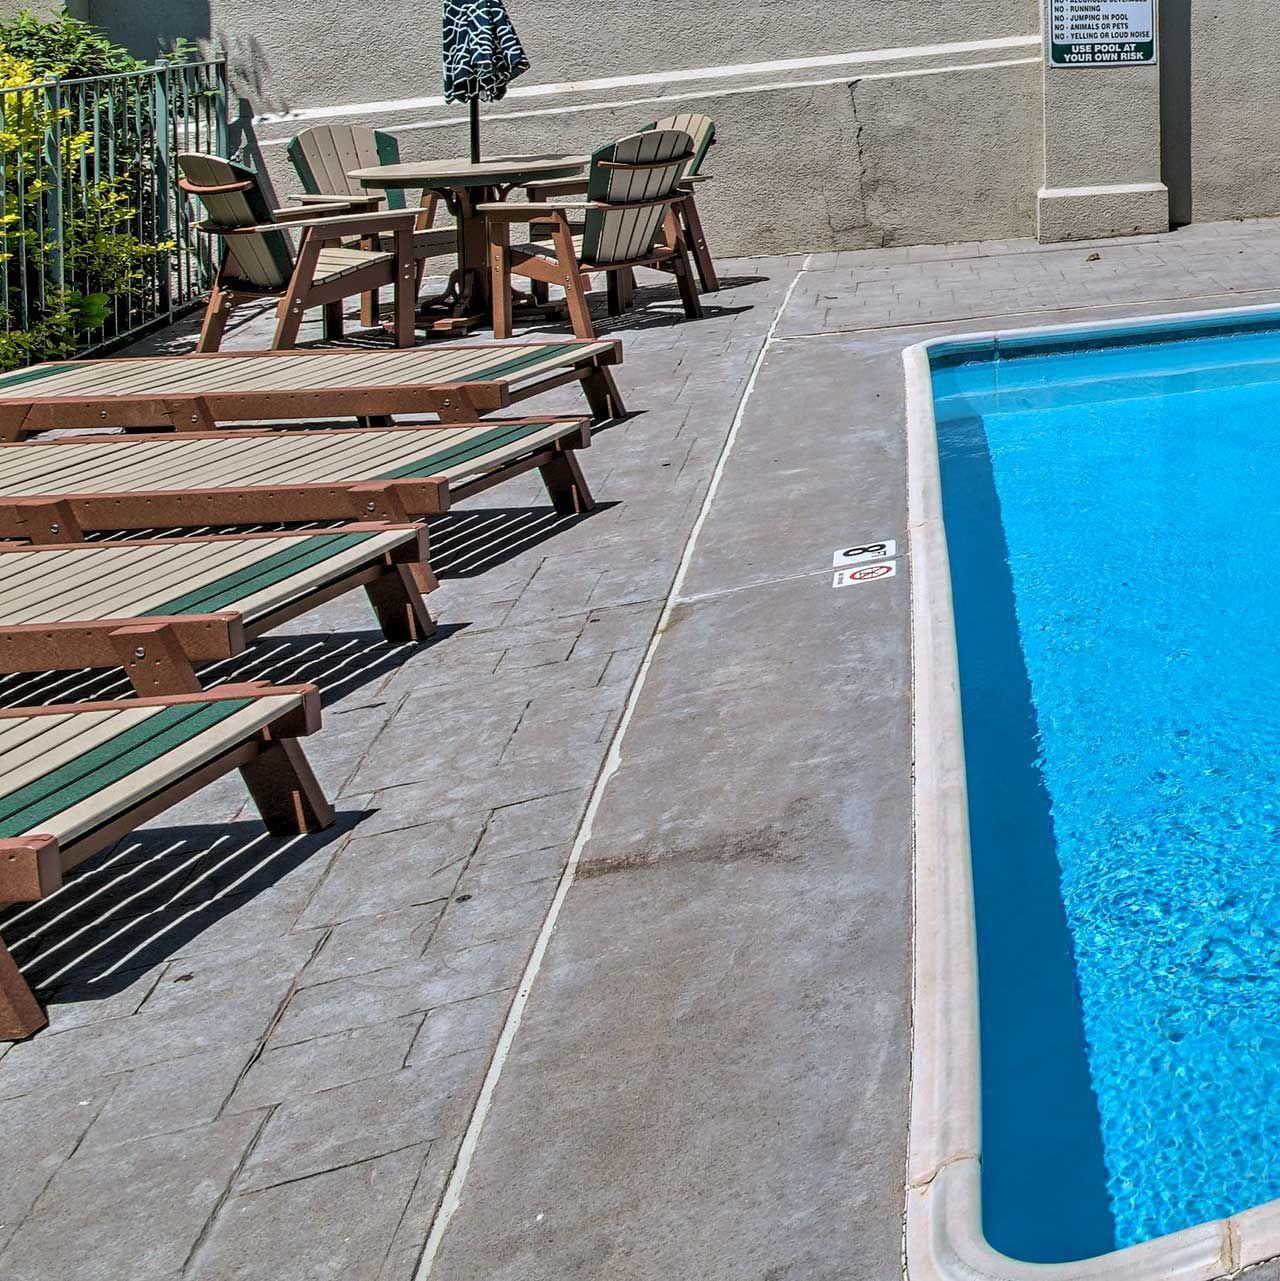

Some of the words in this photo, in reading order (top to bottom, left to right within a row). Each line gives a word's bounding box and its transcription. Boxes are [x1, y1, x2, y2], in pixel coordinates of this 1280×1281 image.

[1095, 53, 1117, 61] OWN
[1121, 52, 1144, 60] RISK
[842, 544, 886, 557] 8
